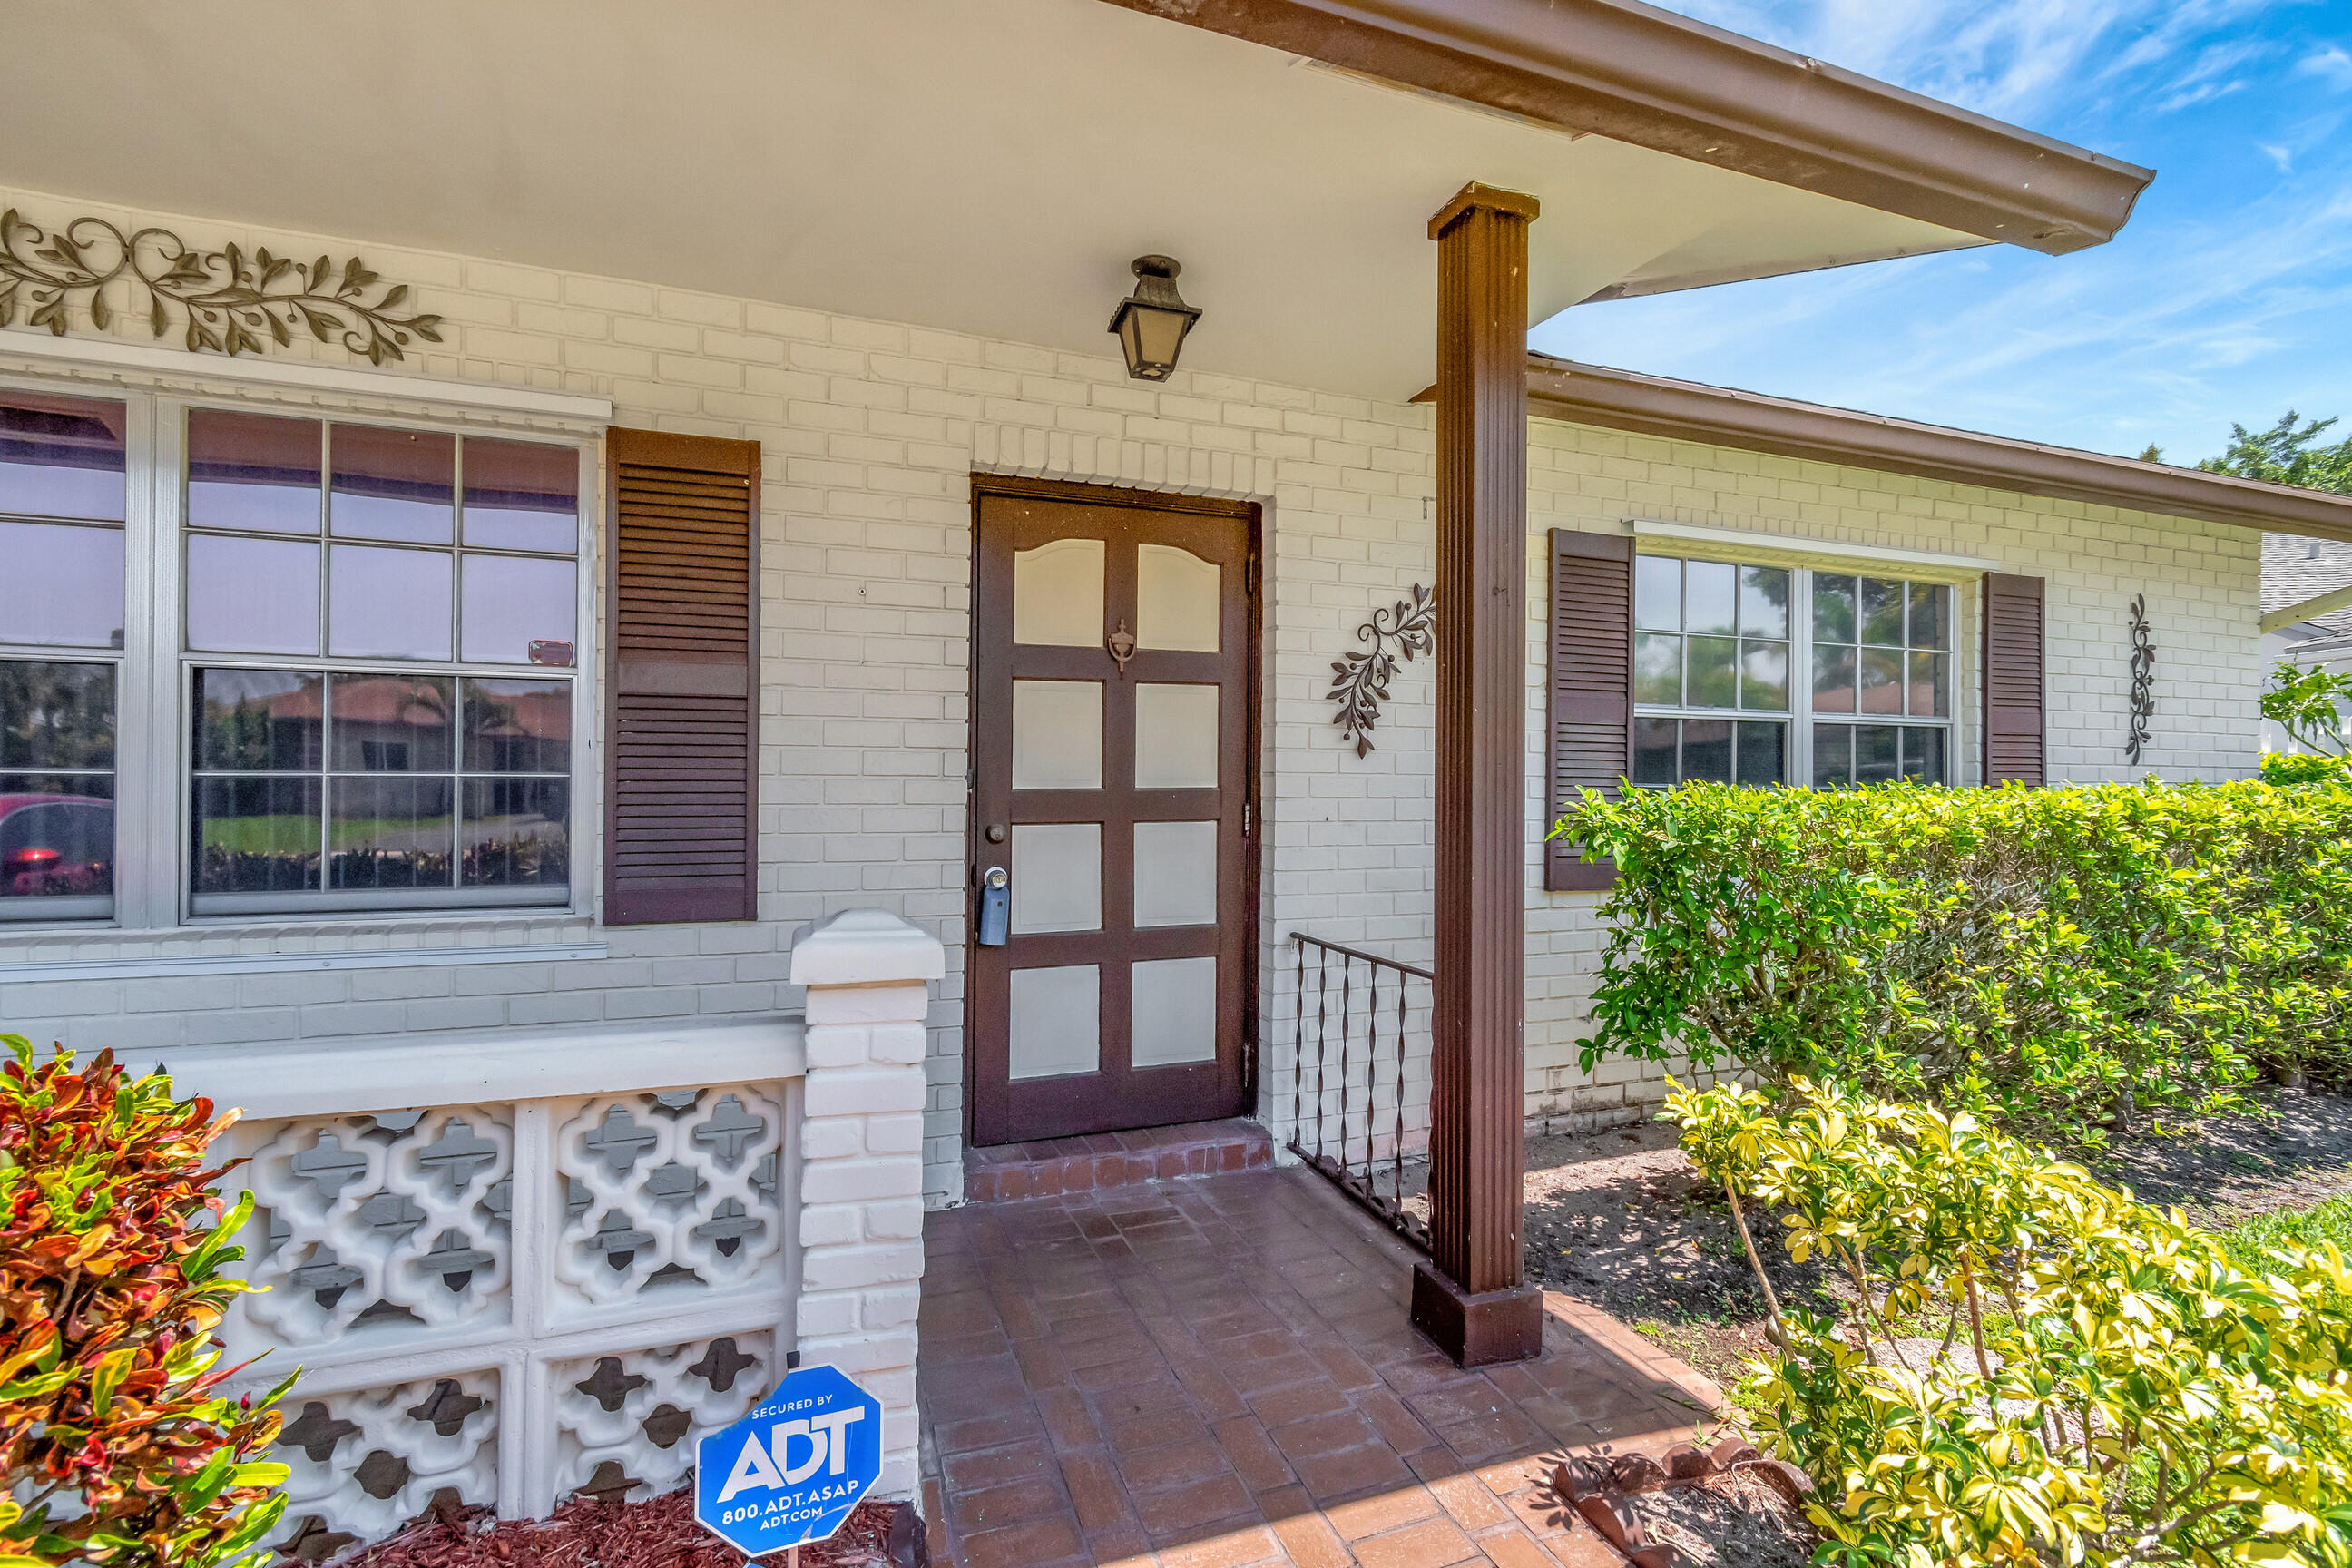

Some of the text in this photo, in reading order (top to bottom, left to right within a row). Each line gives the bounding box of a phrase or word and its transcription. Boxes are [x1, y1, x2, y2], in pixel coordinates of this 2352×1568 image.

[751, 1394, 833, 1419] SECURED BY
[716, 1406, 865, 1504] ADT
[721, 1479, 859, 1525] 800.ADT.ASAP
[760, 1506, 823, 1531] ADT.COM
